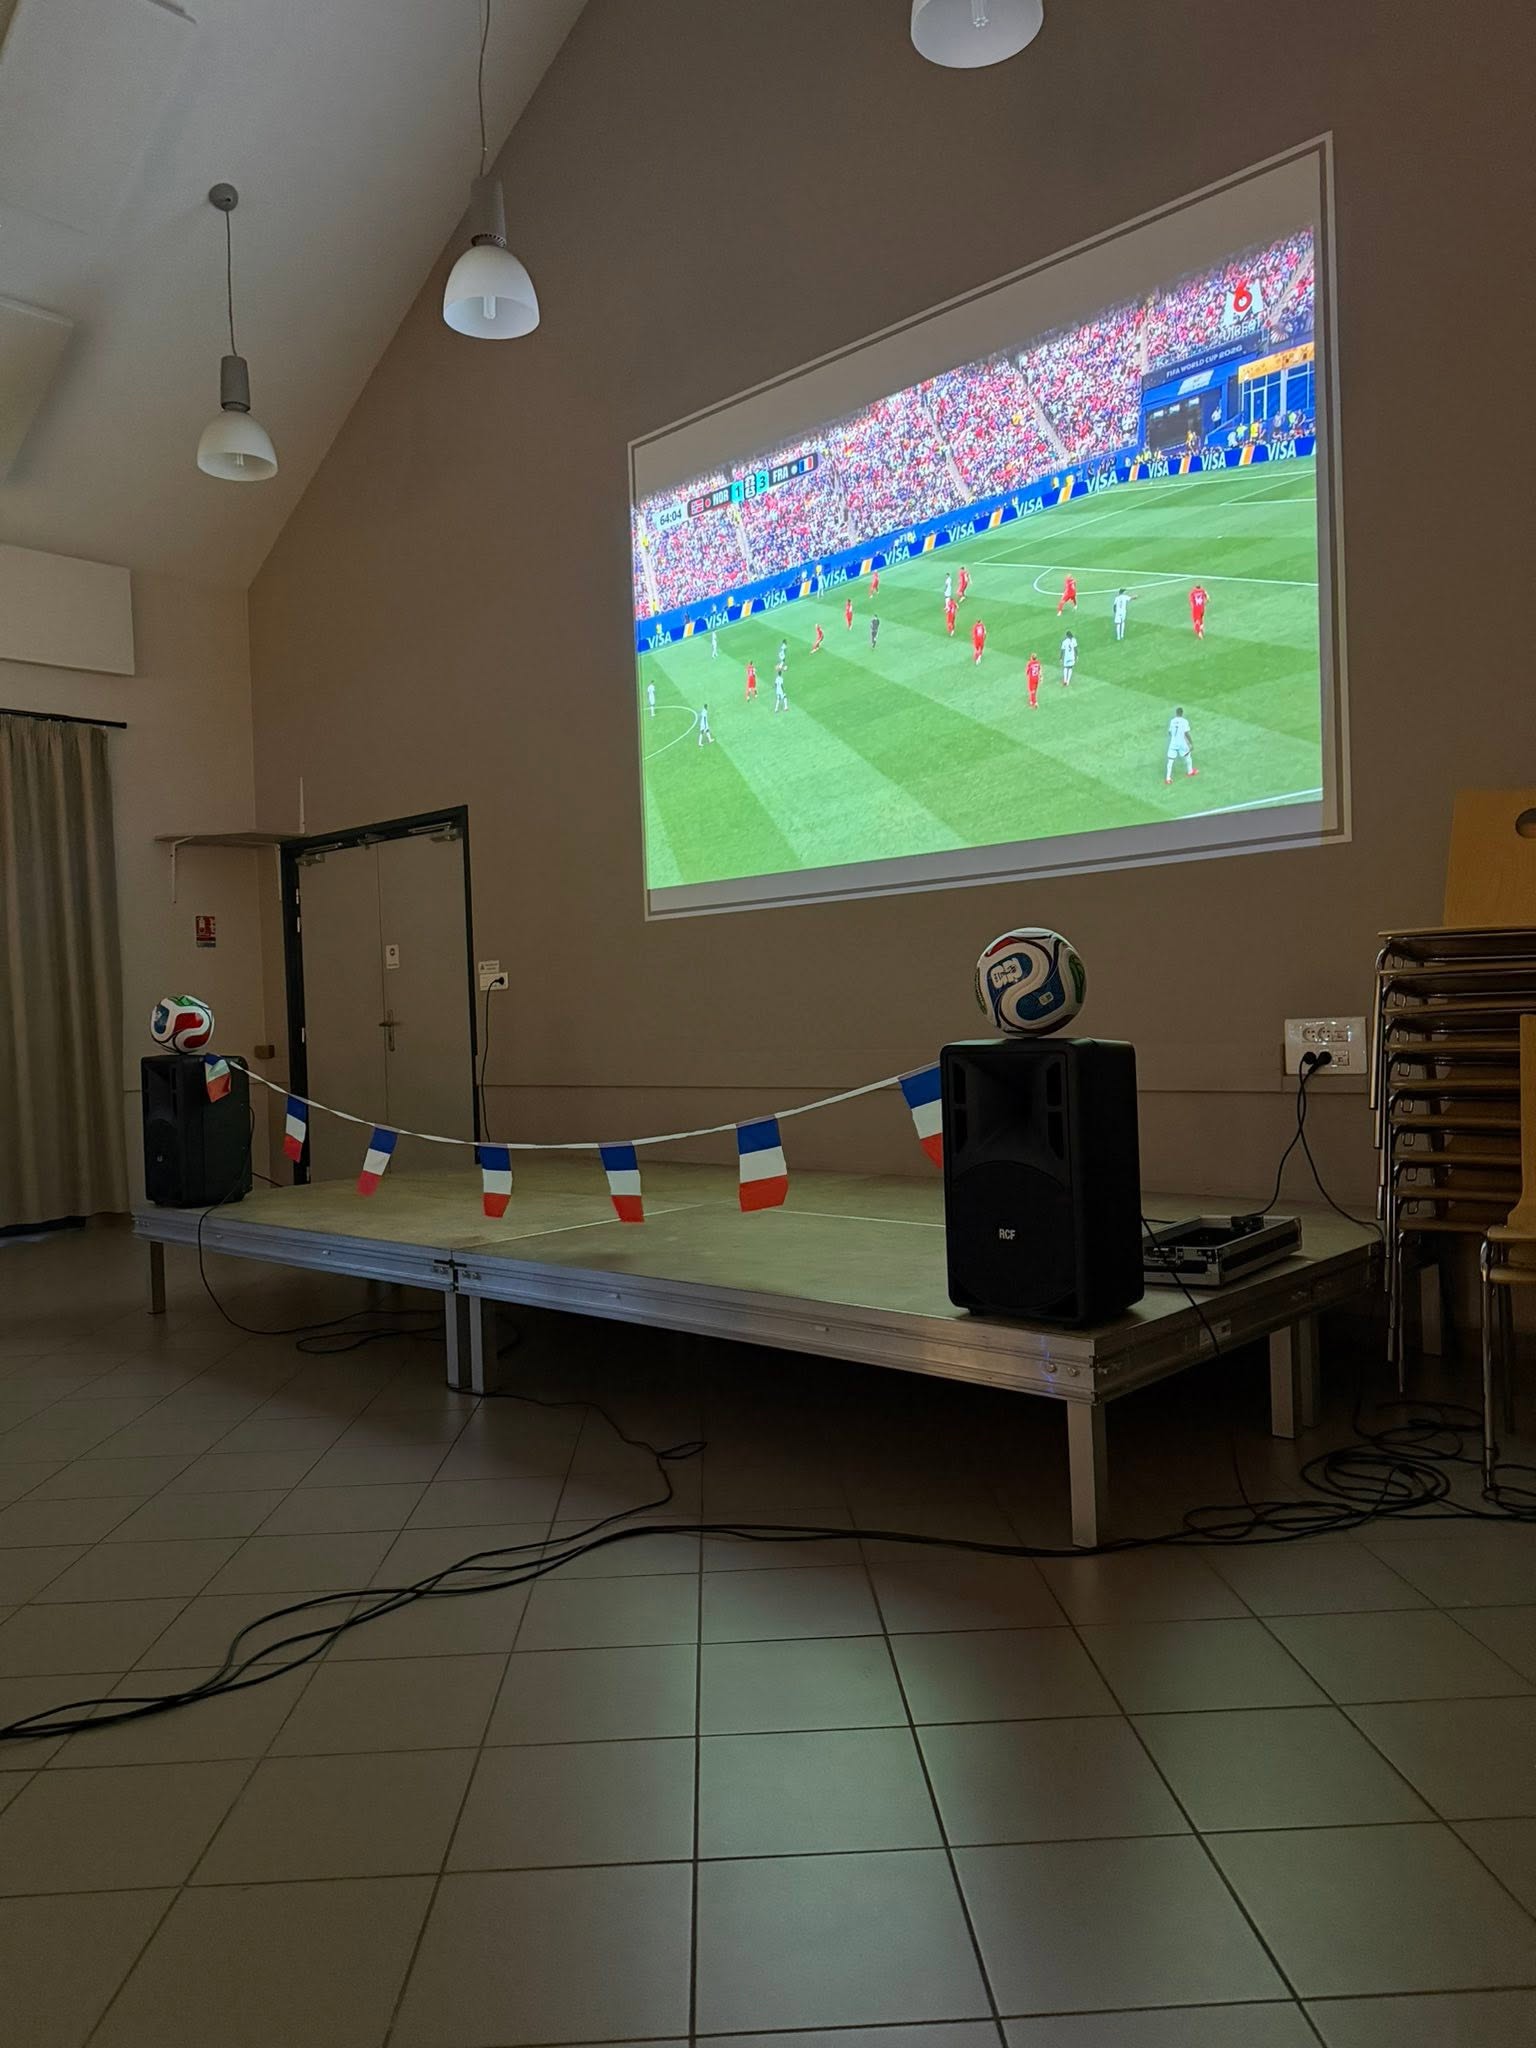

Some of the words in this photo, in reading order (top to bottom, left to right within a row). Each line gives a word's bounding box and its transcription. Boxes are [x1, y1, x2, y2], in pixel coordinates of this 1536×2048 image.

[1166, 368, 1181, 379] FIFA
[1181, 360, 1205, 373] WORLD
[1205, 354, 1218, 364] CUP
[1218, 345, 1243, 359] 2026
[1266, 440, 1297, 460] VISA
[1147, 460, 1169, 479] VISA
[1200, 451, 1226, 471] VISA
[1085, 470, 1118, 493] VISA
[659, 508, 682, 526] 64:04
[712, 490, 729, 506] NOR
[759, 475, 766, 489] 3
[772, 468, 789, 483] FRA
[1015, 496, 1044, 517] VISA
[948, 521, 975, 543] VISA
[884, 546, 910, 566] VISA
[823, 569, 848, 588] VISA
[763, 590, 788, 610] VISA
[706, 610, 730, 629] VISA
[647, 631, 673, 649] VISA
[999, 1227, 1016, 1240] RCF
